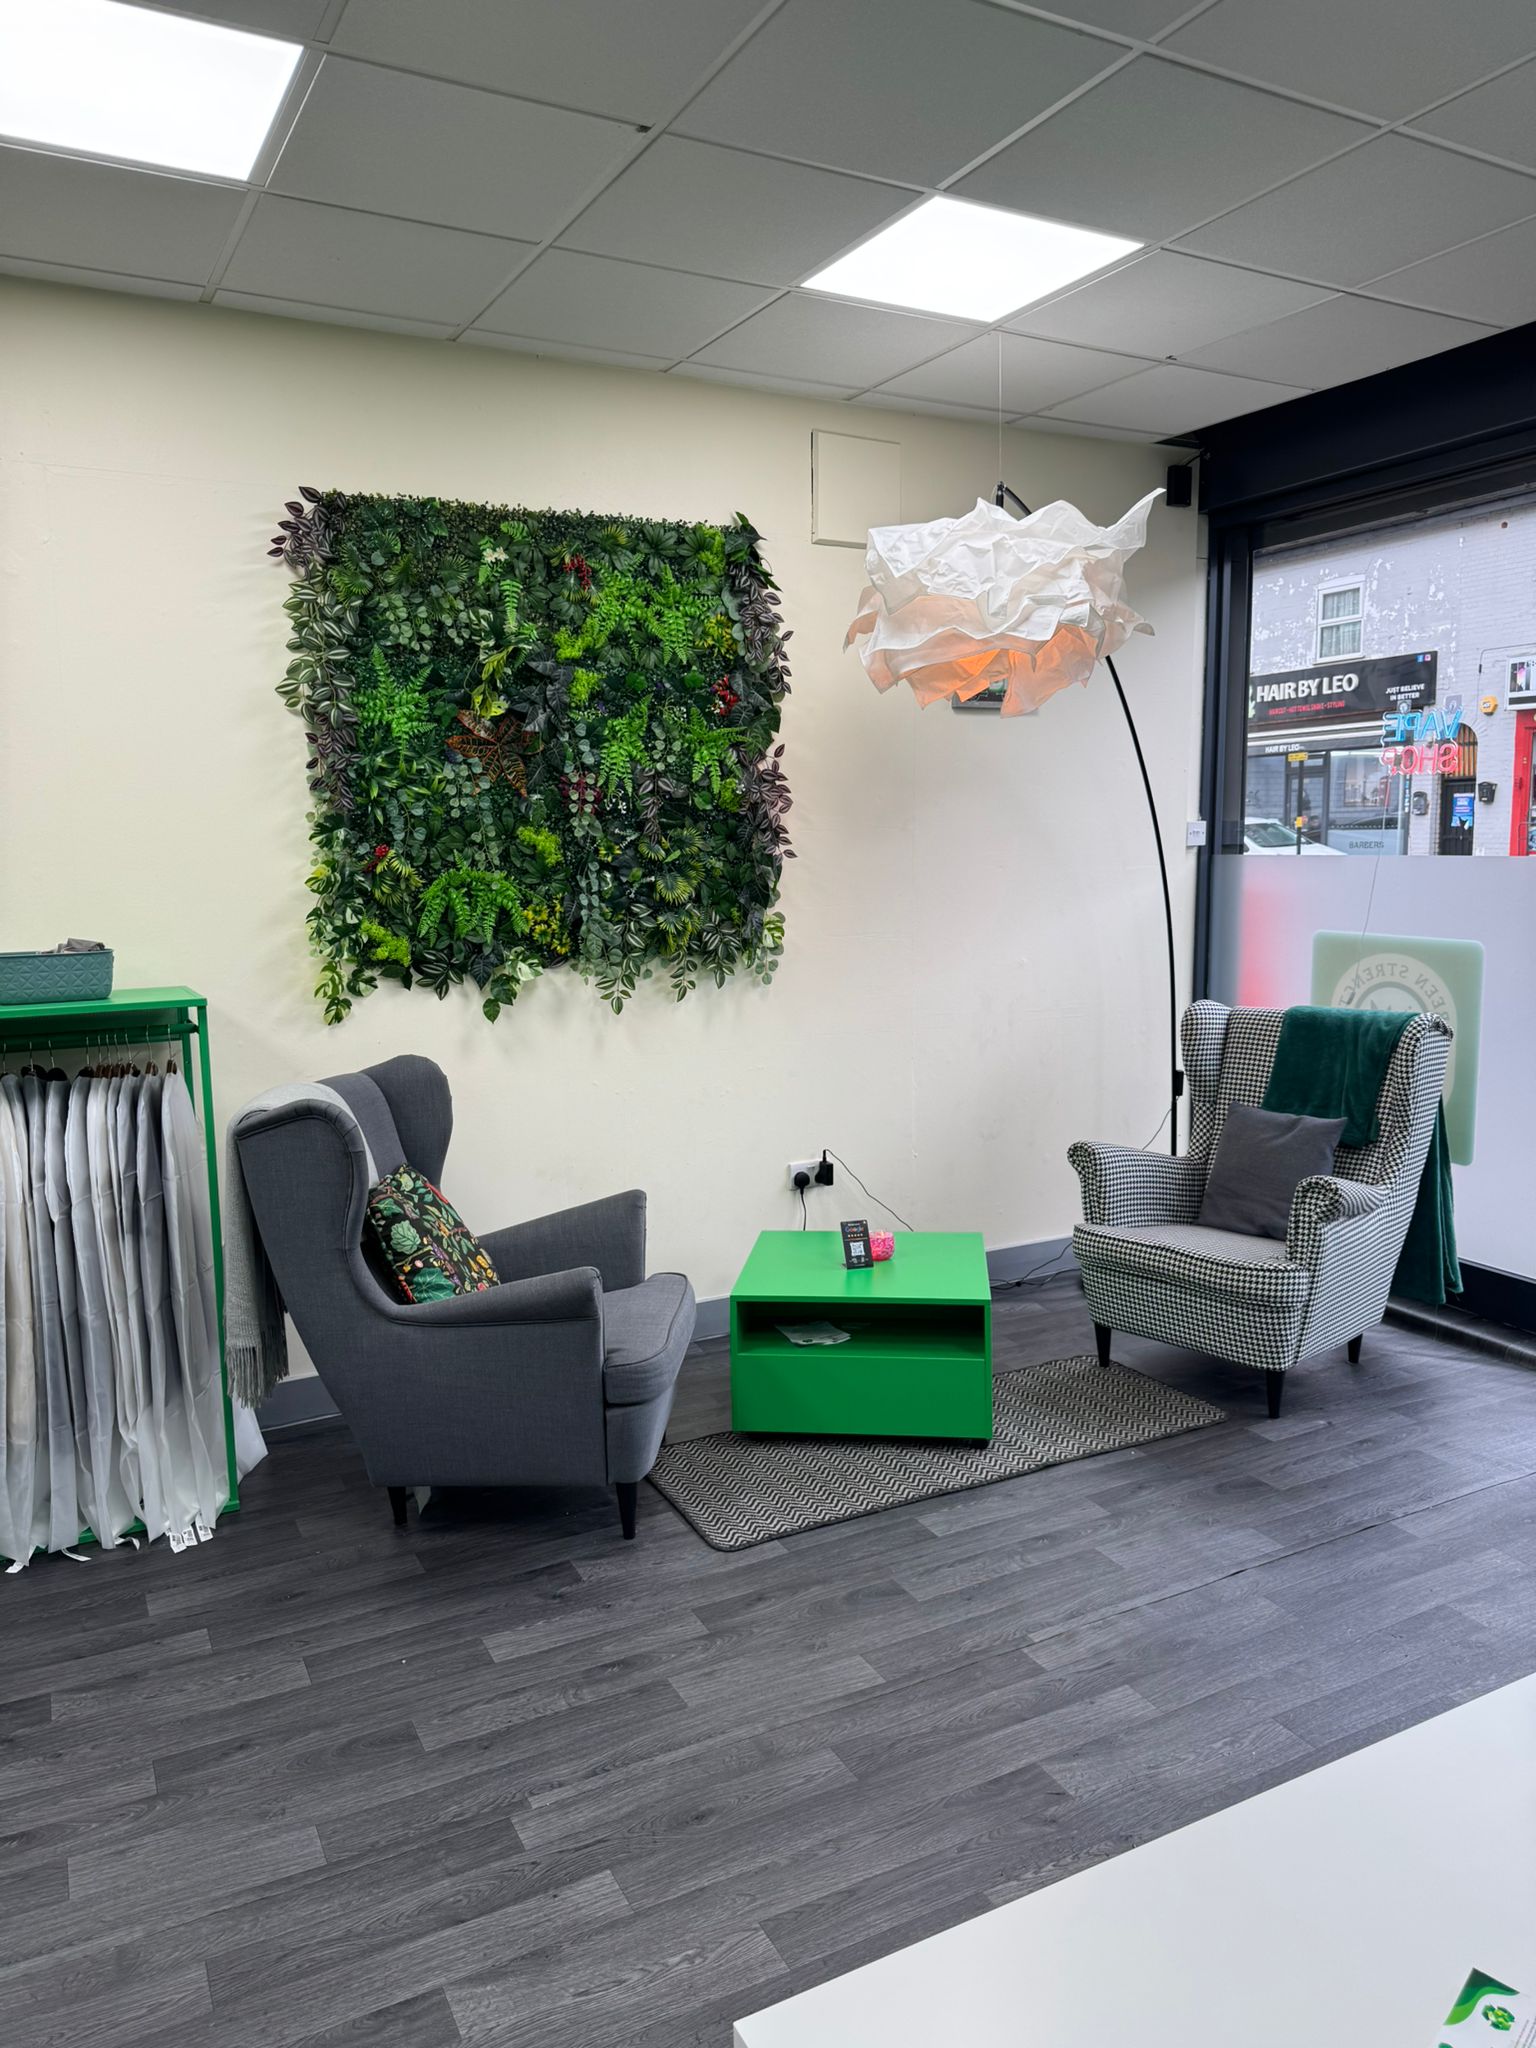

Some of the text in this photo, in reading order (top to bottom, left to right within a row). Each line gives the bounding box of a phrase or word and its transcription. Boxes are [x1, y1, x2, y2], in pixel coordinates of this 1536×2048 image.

[1256, 673, 1359, 702] HAIR BY LEO
[1386, 684, 1425, 694] JUST BELIEVE
[1397, 692, 1420, 700] BETTER
[1265, 745, 1279, 753] HAIR
[1279, 745, 1288, 753] BY
[1349, 840, 1385, 849] BARBERS
